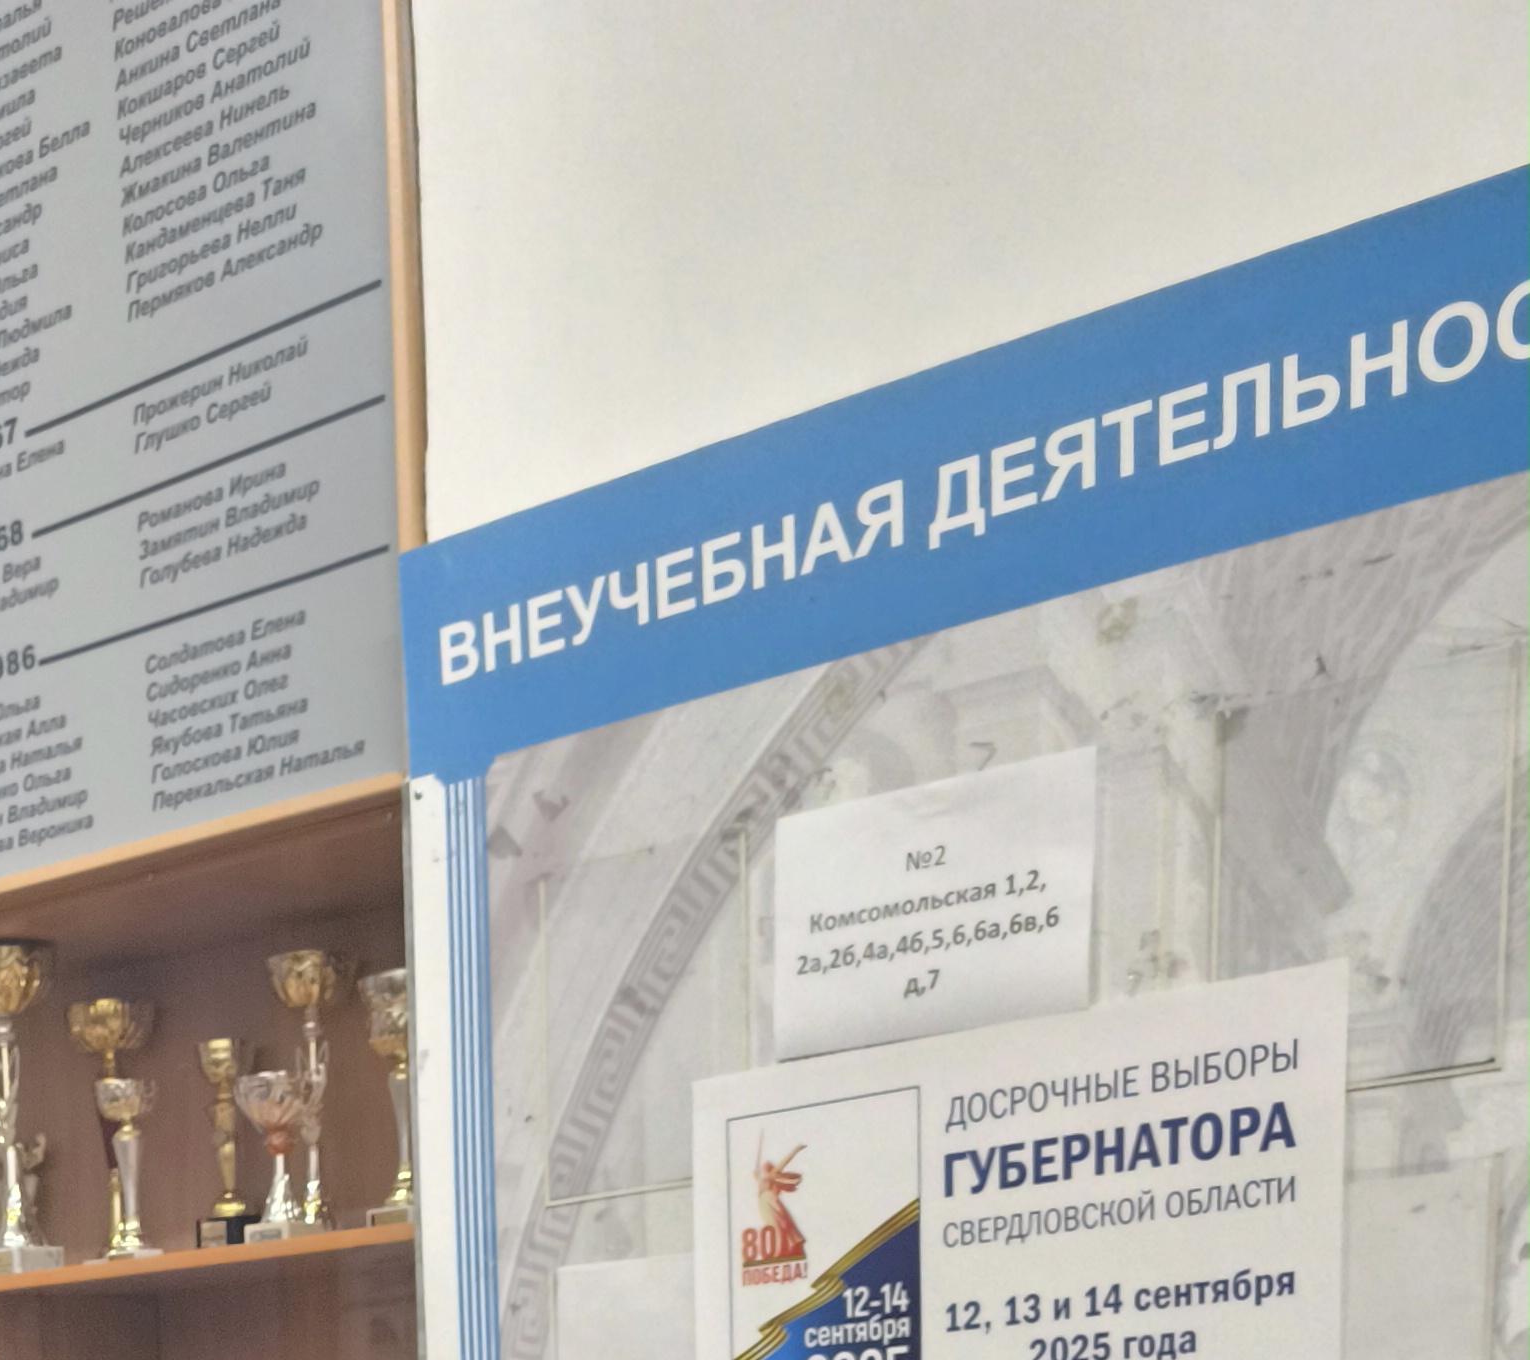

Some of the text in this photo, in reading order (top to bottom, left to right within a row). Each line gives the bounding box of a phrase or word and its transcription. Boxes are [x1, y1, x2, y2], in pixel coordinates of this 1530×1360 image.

[117, 21, 280, 120] Кокшаров Сергей
[119, 38, 310, 145] Черников Анатолий
[38, 121, 90, 159] Белла
[119, 86, 289, 178] Алексеева Нинель
[121, 102, 316, 208] Жмакина Валентина
[122, 156, 269, 237] Колосова Ольга
[125, 168, 305, 264] Кандаменцева Таня
[126, 204, 296, 294] Григорьева Нелли
[127, 223, 322, 322] Пермяков Александр
[133, 337, 307, 425] Прожерин Николай
[134, 382, 271, 454] Глушко Сергей
[16, 440, 64, 473] Елена
[137, 463, 285, 532] Романова Ирина
[139, 481, 319, 561] Замятин Владимир
[2, 557, 40, 584] Вера
[140, 514, 306, 588] Голубева Надежда
[439, 479, 905, 686] ВНЕУЧЕБНАЯ
[145, 611, 305, 675] Солдатова Елена
[146, 645, 291, 702] Сидоренко Анна
[244, 675, 288, 700] Олег
[10, 737, 82, 770] Наталья
[26, 715, 66, 739] Алла
[150, 699, 307, 757] Якубова Татьяна
[247, 730, 299, 757] Юлия
[279, 741, 364, 776] Наталья
[7, 790, 87, 824] Владимир
[23, 768, 71, 792] Ольга
[18, 815, 93, 848] Вероника
[905, 844, 947, 872] №2
[809, 869, 1047, 934] Комсомольская 1,2,
[903, 969, 941, 999] д,7
[944, 1038, 1299, 1134] ДОСРОЧНЫЕ ВЫБОРЫ
[943, 1100, 1297, 1199] ГУБЕРНАТОРА
[943, 1175, 1297, 1249] СВЕРДЛОВСКОЙ ОБЛАСТИ
[742, 1262, 808, 1287] ПОБЕДА!
[843, 1281, 910, 1318] 12-14
[945, 1267, 1297, 1335] 12, 13 и 14 сентября
[803, 1314, 911, 1349] сентября
